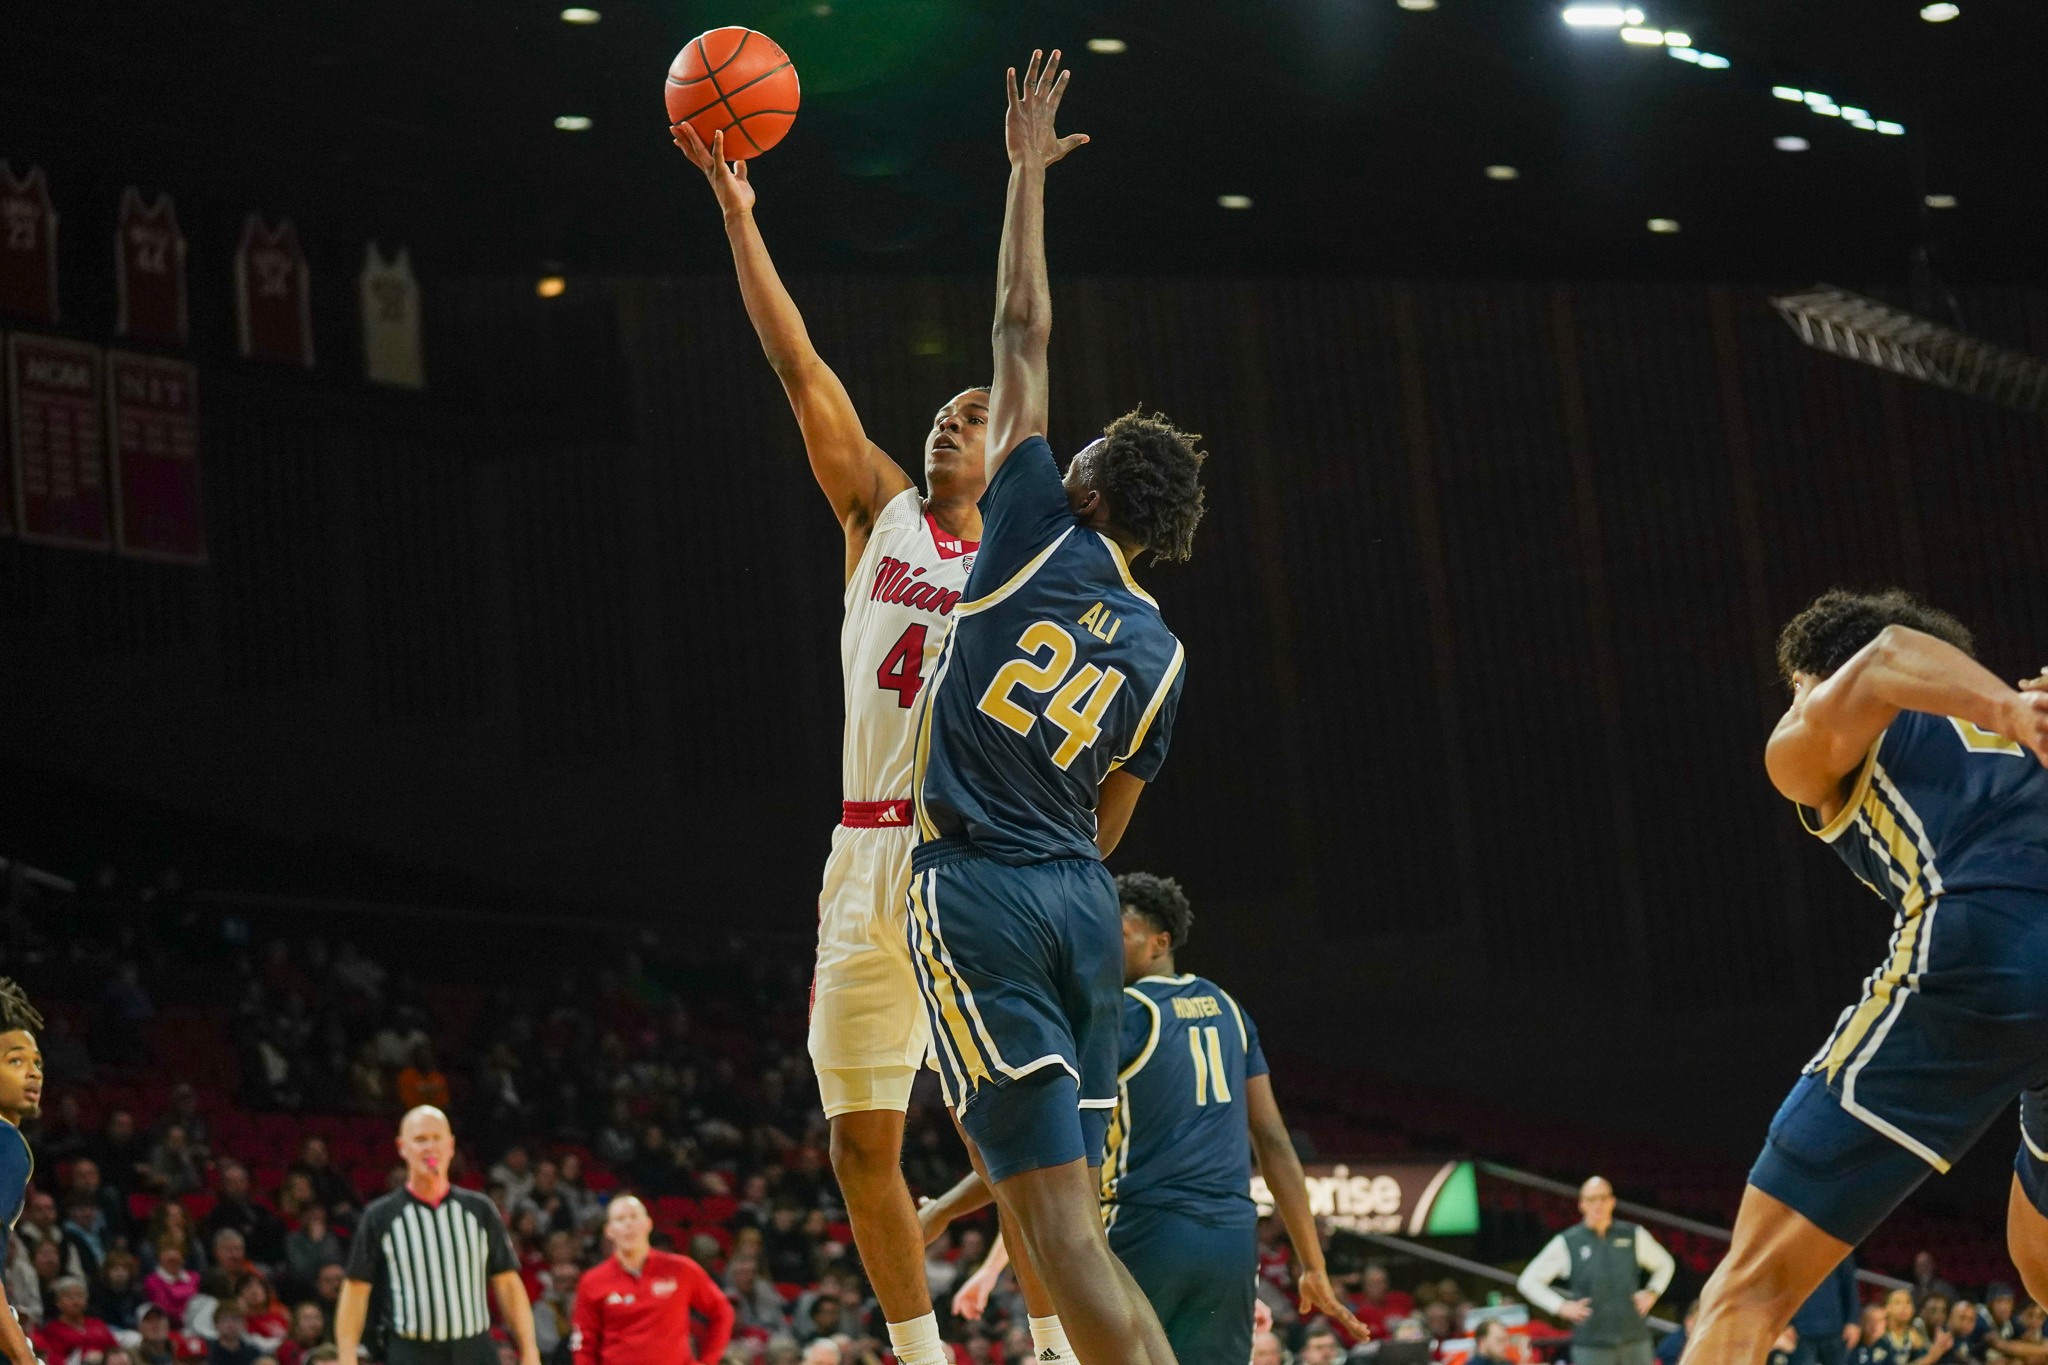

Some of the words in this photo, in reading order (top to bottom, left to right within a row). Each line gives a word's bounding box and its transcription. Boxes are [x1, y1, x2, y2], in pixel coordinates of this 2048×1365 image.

[1077, 601, 1122, 644] ALI
[877, 622, 928, 709] 4
[978, 621, 1126, 771] 24
[1171, 995, 1222, 1019] HUNTER
[1188, 1026, 1231, 1106] 11
